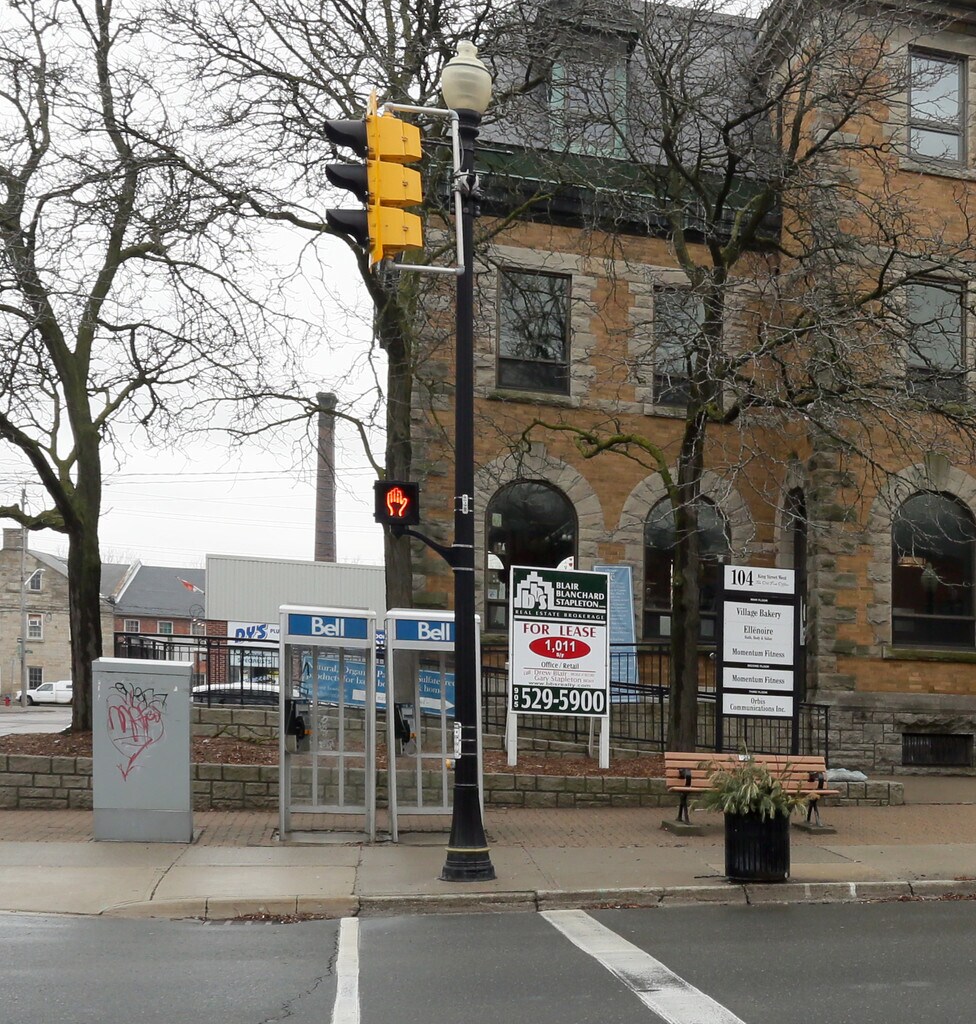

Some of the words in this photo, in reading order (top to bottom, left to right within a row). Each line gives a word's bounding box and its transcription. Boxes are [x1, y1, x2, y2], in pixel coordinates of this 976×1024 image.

[731, 569, 754, 586] 104
[556, 582, 579, 590] BLAIR
[556, 590, 605, 600] BLANCHARD
[556, 598, 599, 608] STAPLETON
[736, 607, 758, 618] Village
[760, 609, 781, 619] Bakery
[311, 616, 345, 637] Bell
[418, 622, 451, 641] Bell
[523, 623, 550, 635] FOR
[560, 625, 597, 638] LEASE
[545, 639, 576, 653] 1,011
[732, 648, 764, 657] Momentum
[764, 650, 785, 658] Fitness
[732, 674, 764, 683] Momentum
[764, 676, 785, 684] Fitness
[521, 687, 605, 712] 529-5900
[750, 697, 766, 705] Orbis
[729, 703, 775, 712] Communications
[775, 705, 786, 713] Inc.
